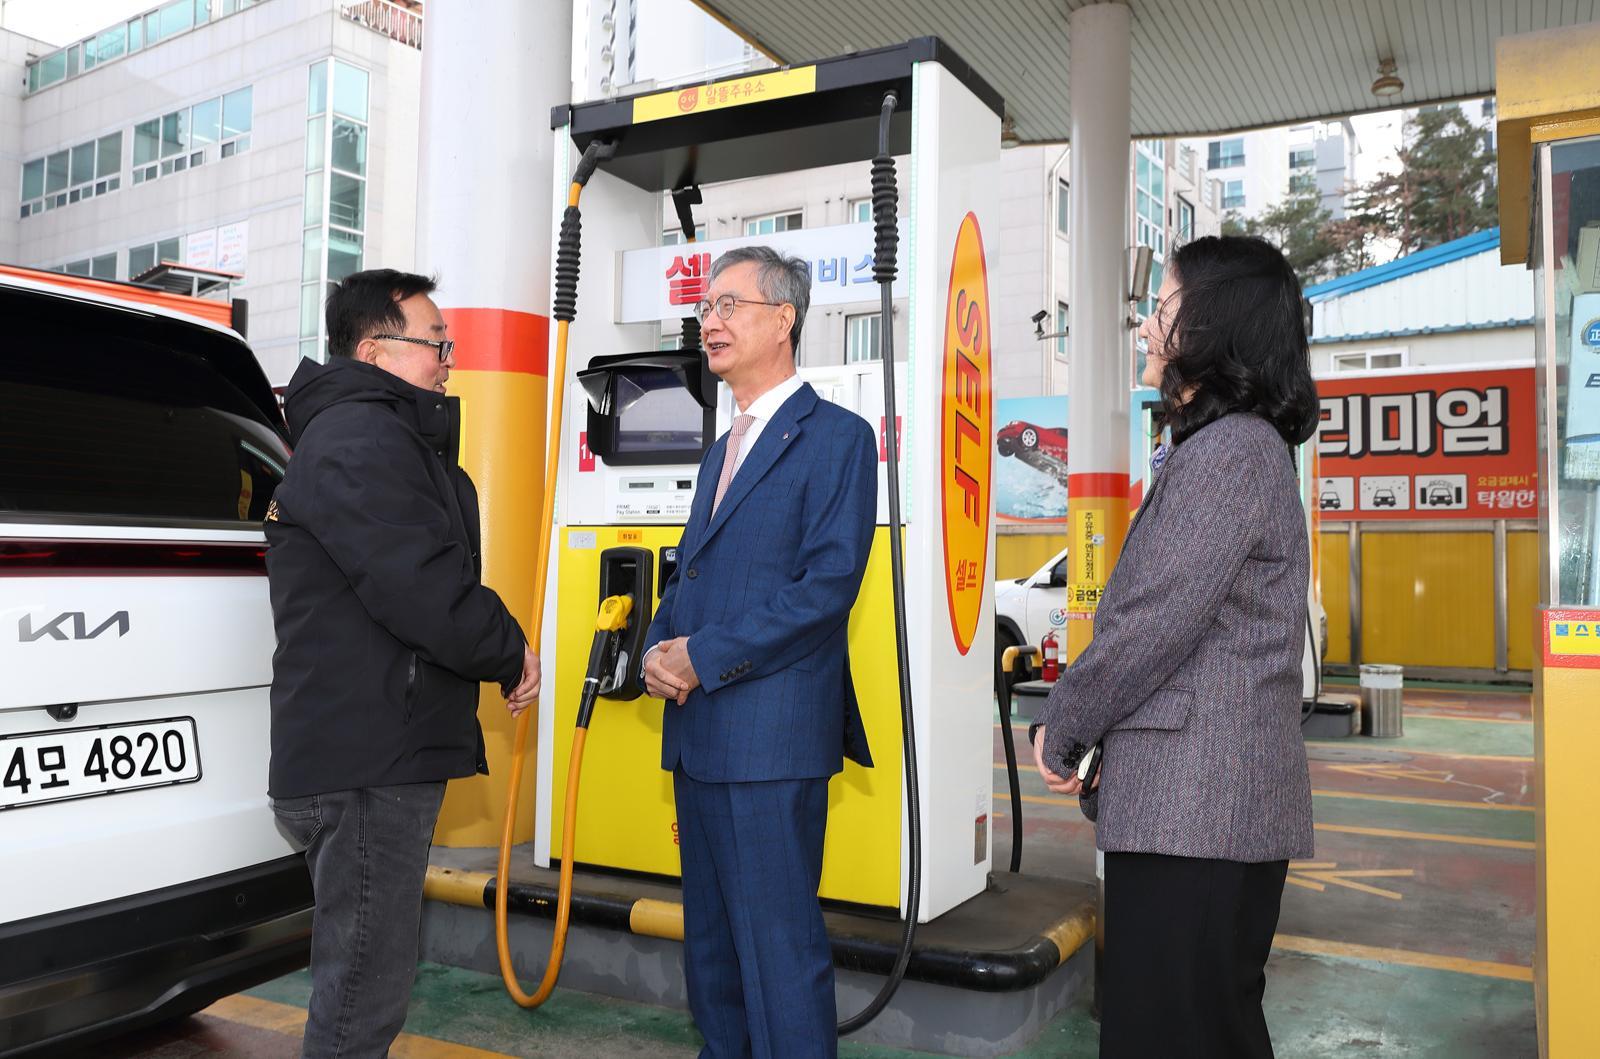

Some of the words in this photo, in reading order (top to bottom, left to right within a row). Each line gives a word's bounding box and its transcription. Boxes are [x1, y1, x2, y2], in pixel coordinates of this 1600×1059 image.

[705, 80, 766, 105] 알뜰주유소
[808, 254, 876, 287] 비스
[955, 288, 983, 528] SELF
[1319, 385, 1509, 460] 리미엄
[1084, 511, 1094, 541] 주유중
[955, 559, 978, 592] 셀프
[1084, 543, 1094, 581] 엔진정지
[83, 729, 187, 783] 4820
